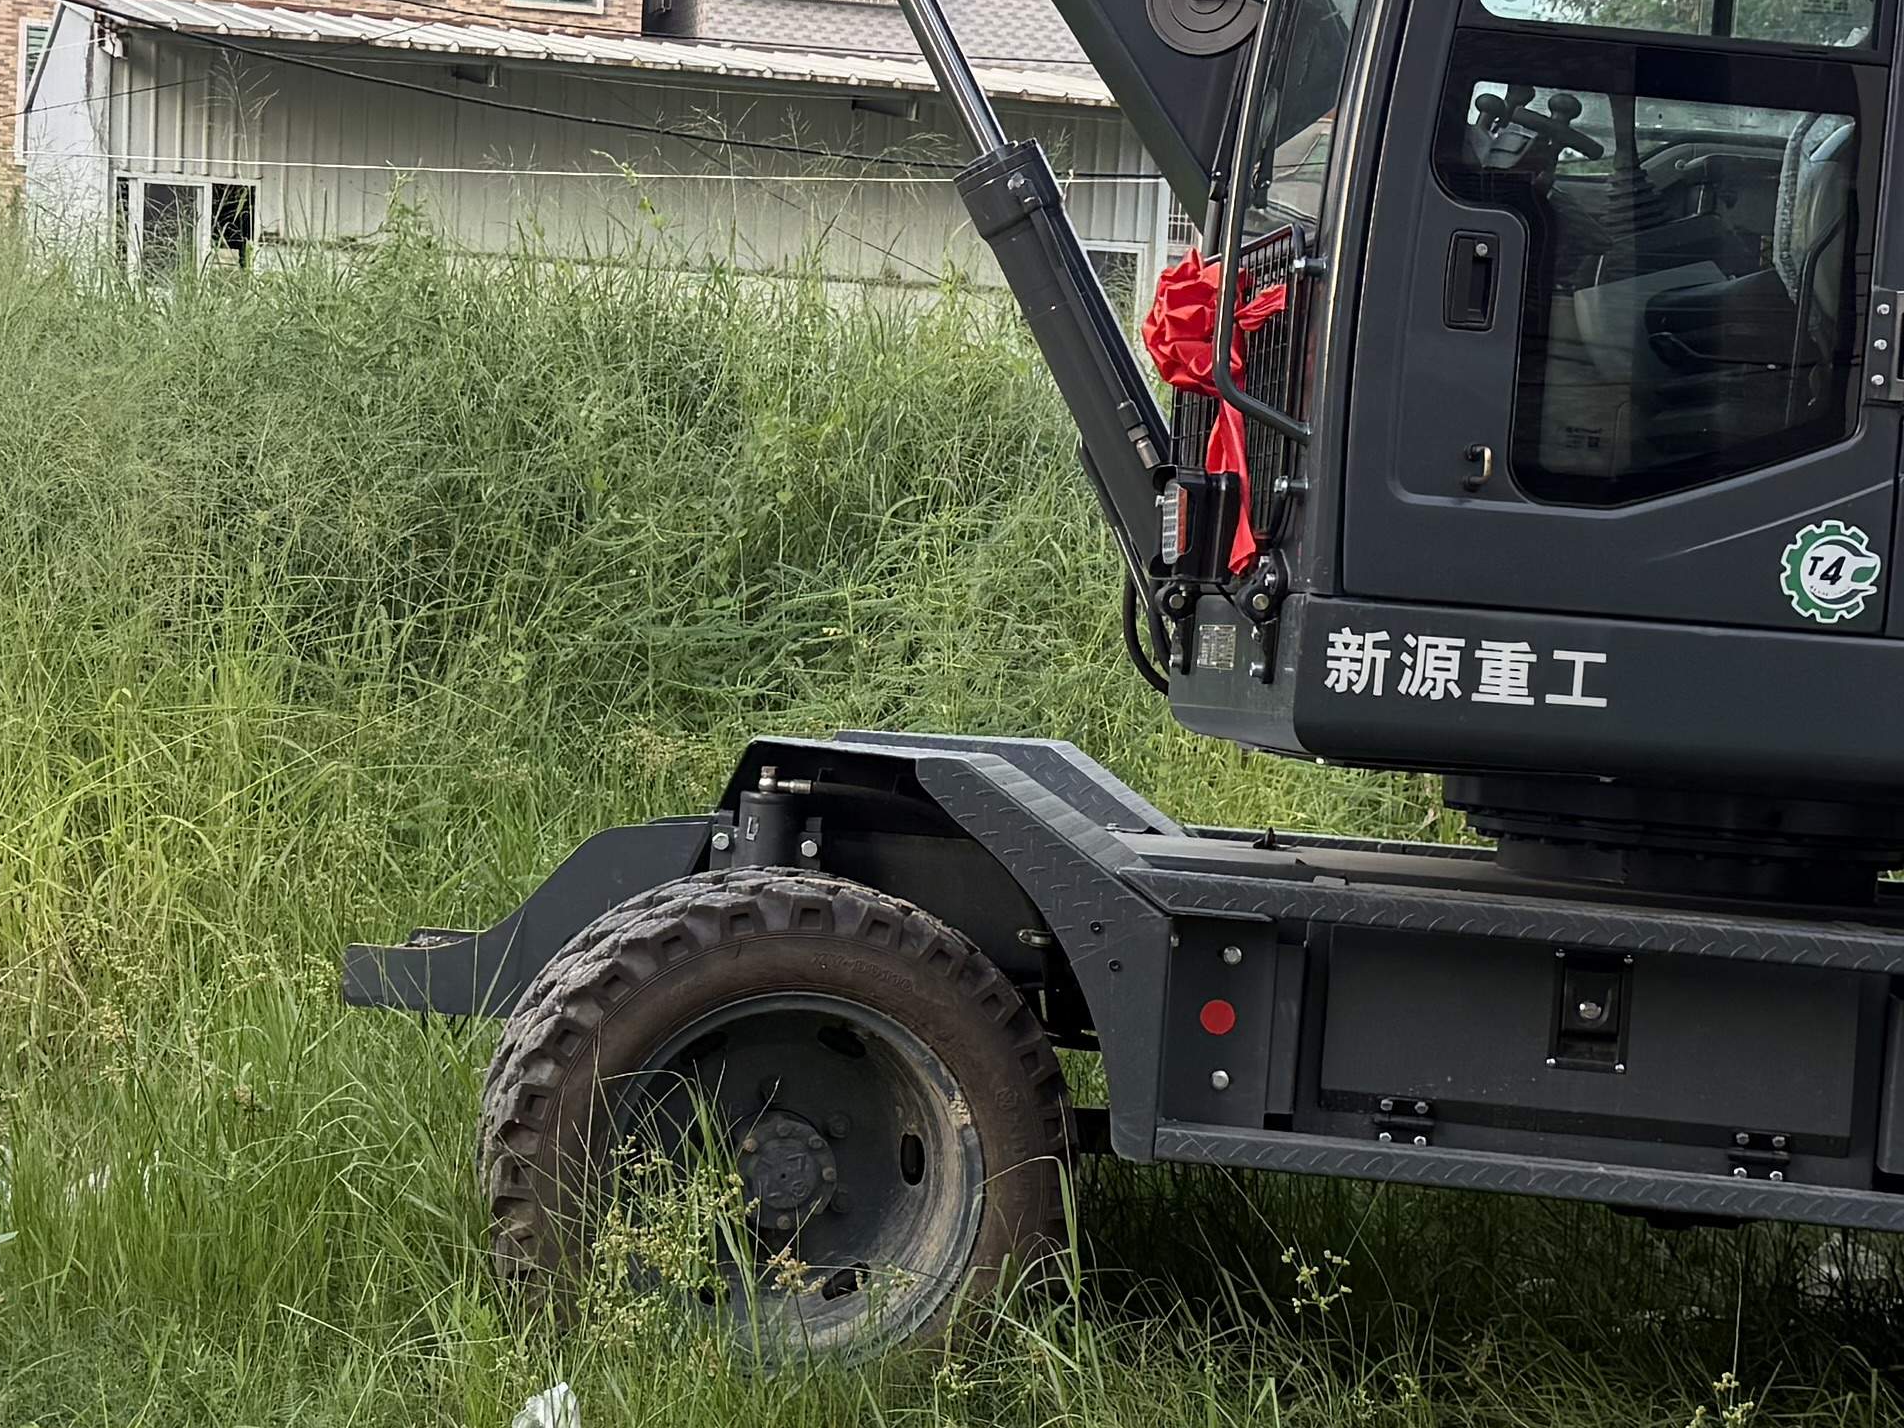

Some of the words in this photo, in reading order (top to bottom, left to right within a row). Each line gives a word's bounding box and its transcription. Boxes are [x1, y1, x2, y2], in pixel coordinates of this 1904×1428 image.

[1808, 556, 1846, 586] T4
[1324, 626, 1609, 709] 新源重工
